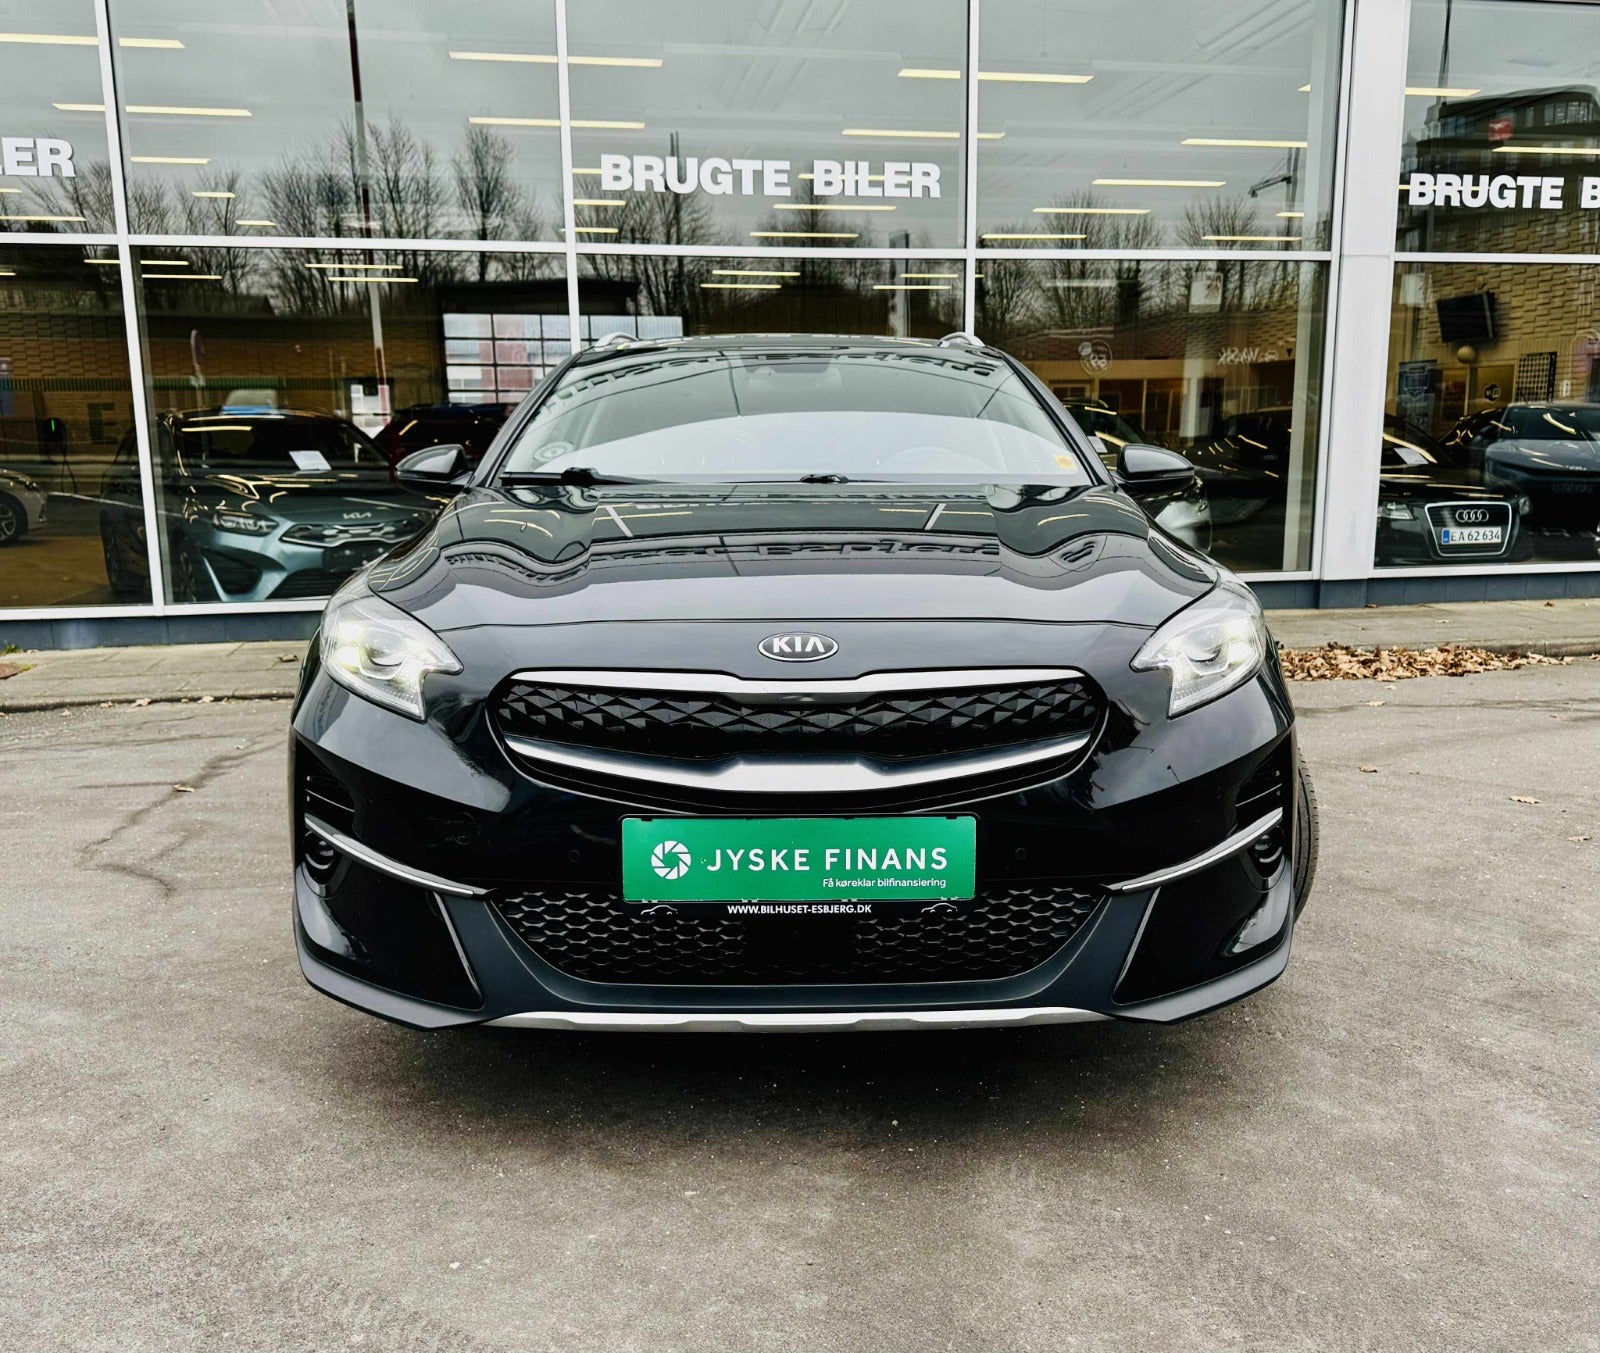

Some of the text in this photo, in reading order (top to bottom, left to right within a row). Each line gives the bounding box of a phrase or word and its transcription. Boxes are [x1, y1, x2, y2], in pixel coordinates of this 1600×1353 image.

[0, 137, 76, 177] ER
[600, 153, 942, 199] BRUGTE BILER
[1408, 172, 1565, 210] BRUGTE
[1450, 531, 1465, 542] EA
[1467, 530, 1480, 541] 62
[772, 636, 826, 653] KIA
[706, 847, 949, 872] JYSKE FINANS
[822, 877, 947, 889] Få køreklar bilfinansiering
[727, 903, 873, 916] WWW.BILHUSET-ESBJERG.DK
